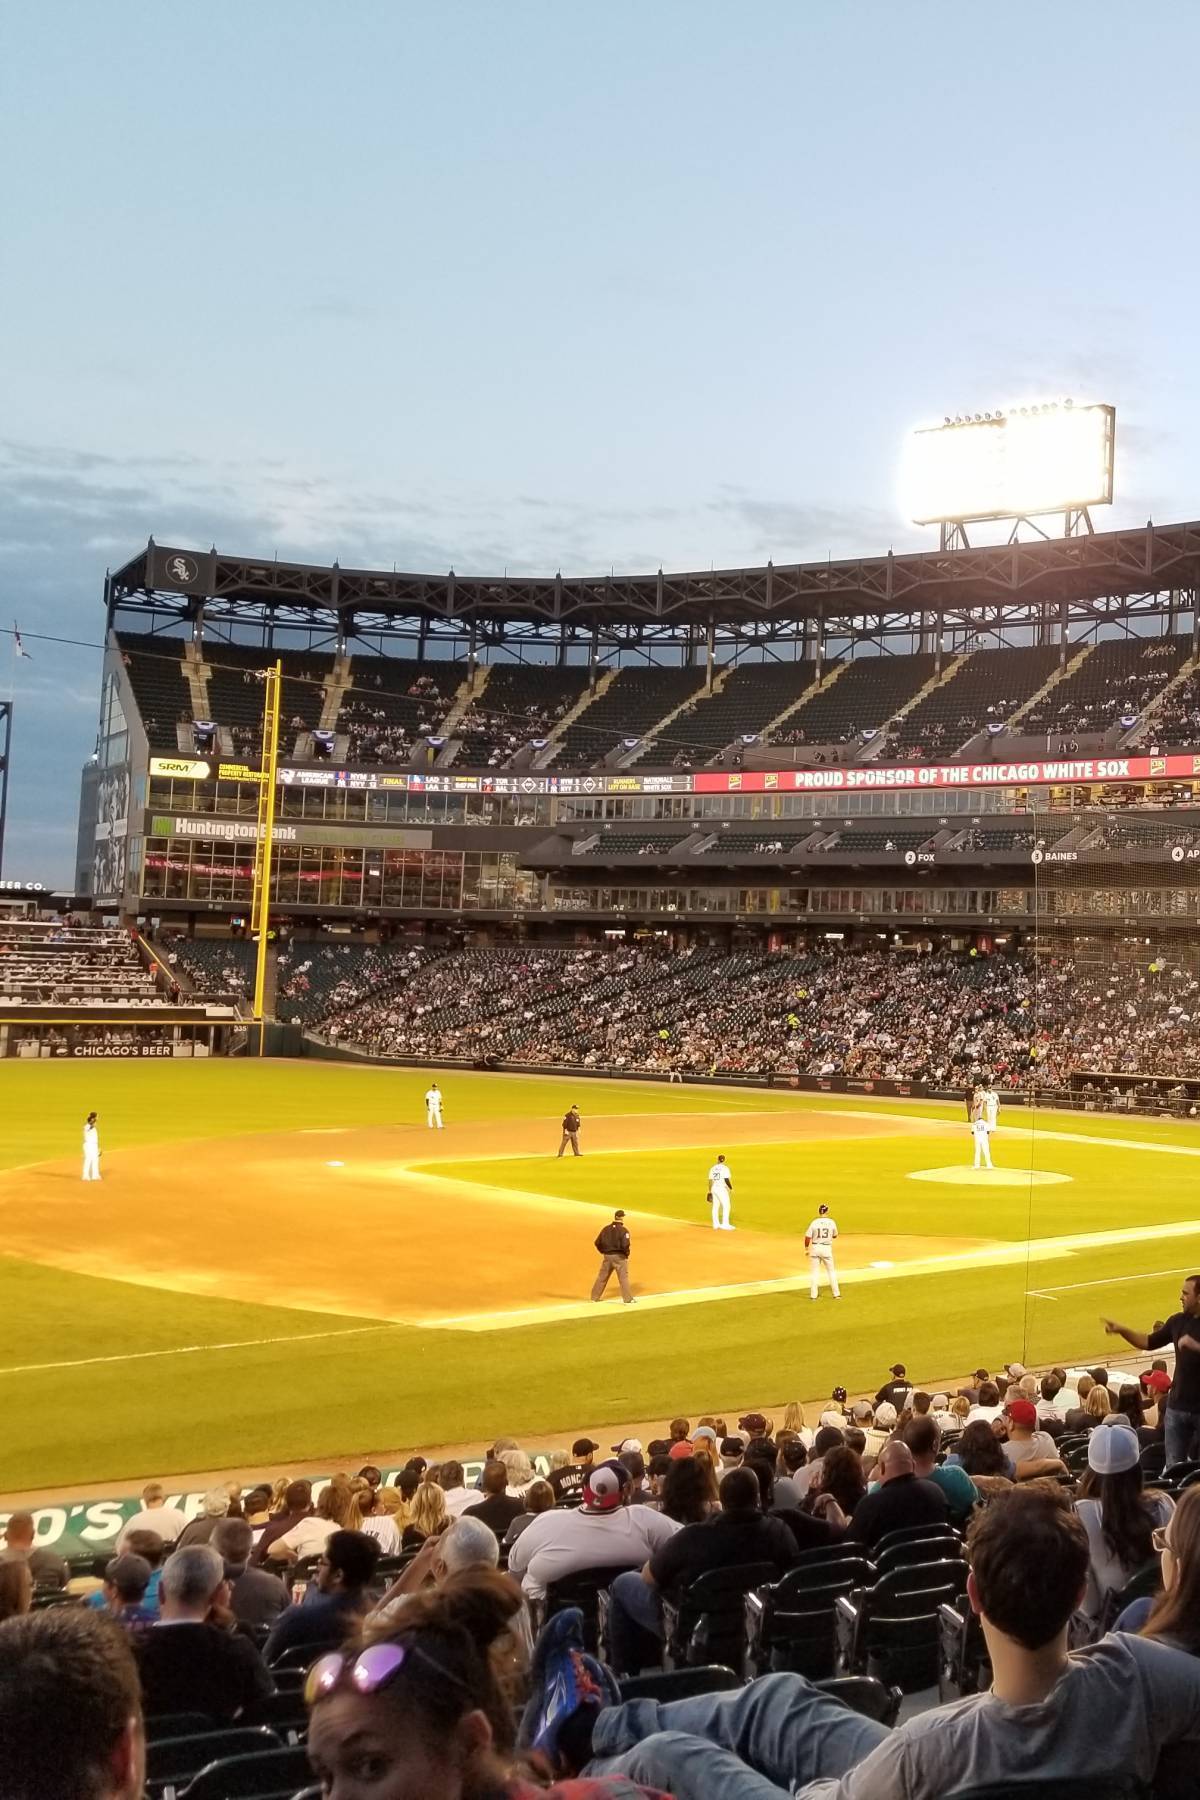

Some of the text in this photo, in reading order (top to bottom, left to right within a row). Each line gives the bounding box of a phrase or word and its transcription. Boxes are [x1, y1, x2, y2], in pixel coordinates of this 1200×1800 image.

[158, 763, 189, 772] SRM
[296, 771, 334, 779] AMERICAN
[795, 759, 1130, 787] PROUD SPONSOR OF THE CHICAGO WHITE SOX
[301, 777, 328, 785] LEAGUE
[350, 780, 365, 788] NYY
[175, 817, 258, 840] Huntington
[917, 853, 935, 862] FOX
[1045, 852, 1078, 861] BAINES
[26, 882, 46, 891] CO.
[233, 1025, 248, 1033] 335
[74, 1045, 171, 1056] CHICAGO'S BEER
[816, 1228, 829, 1239] 13
